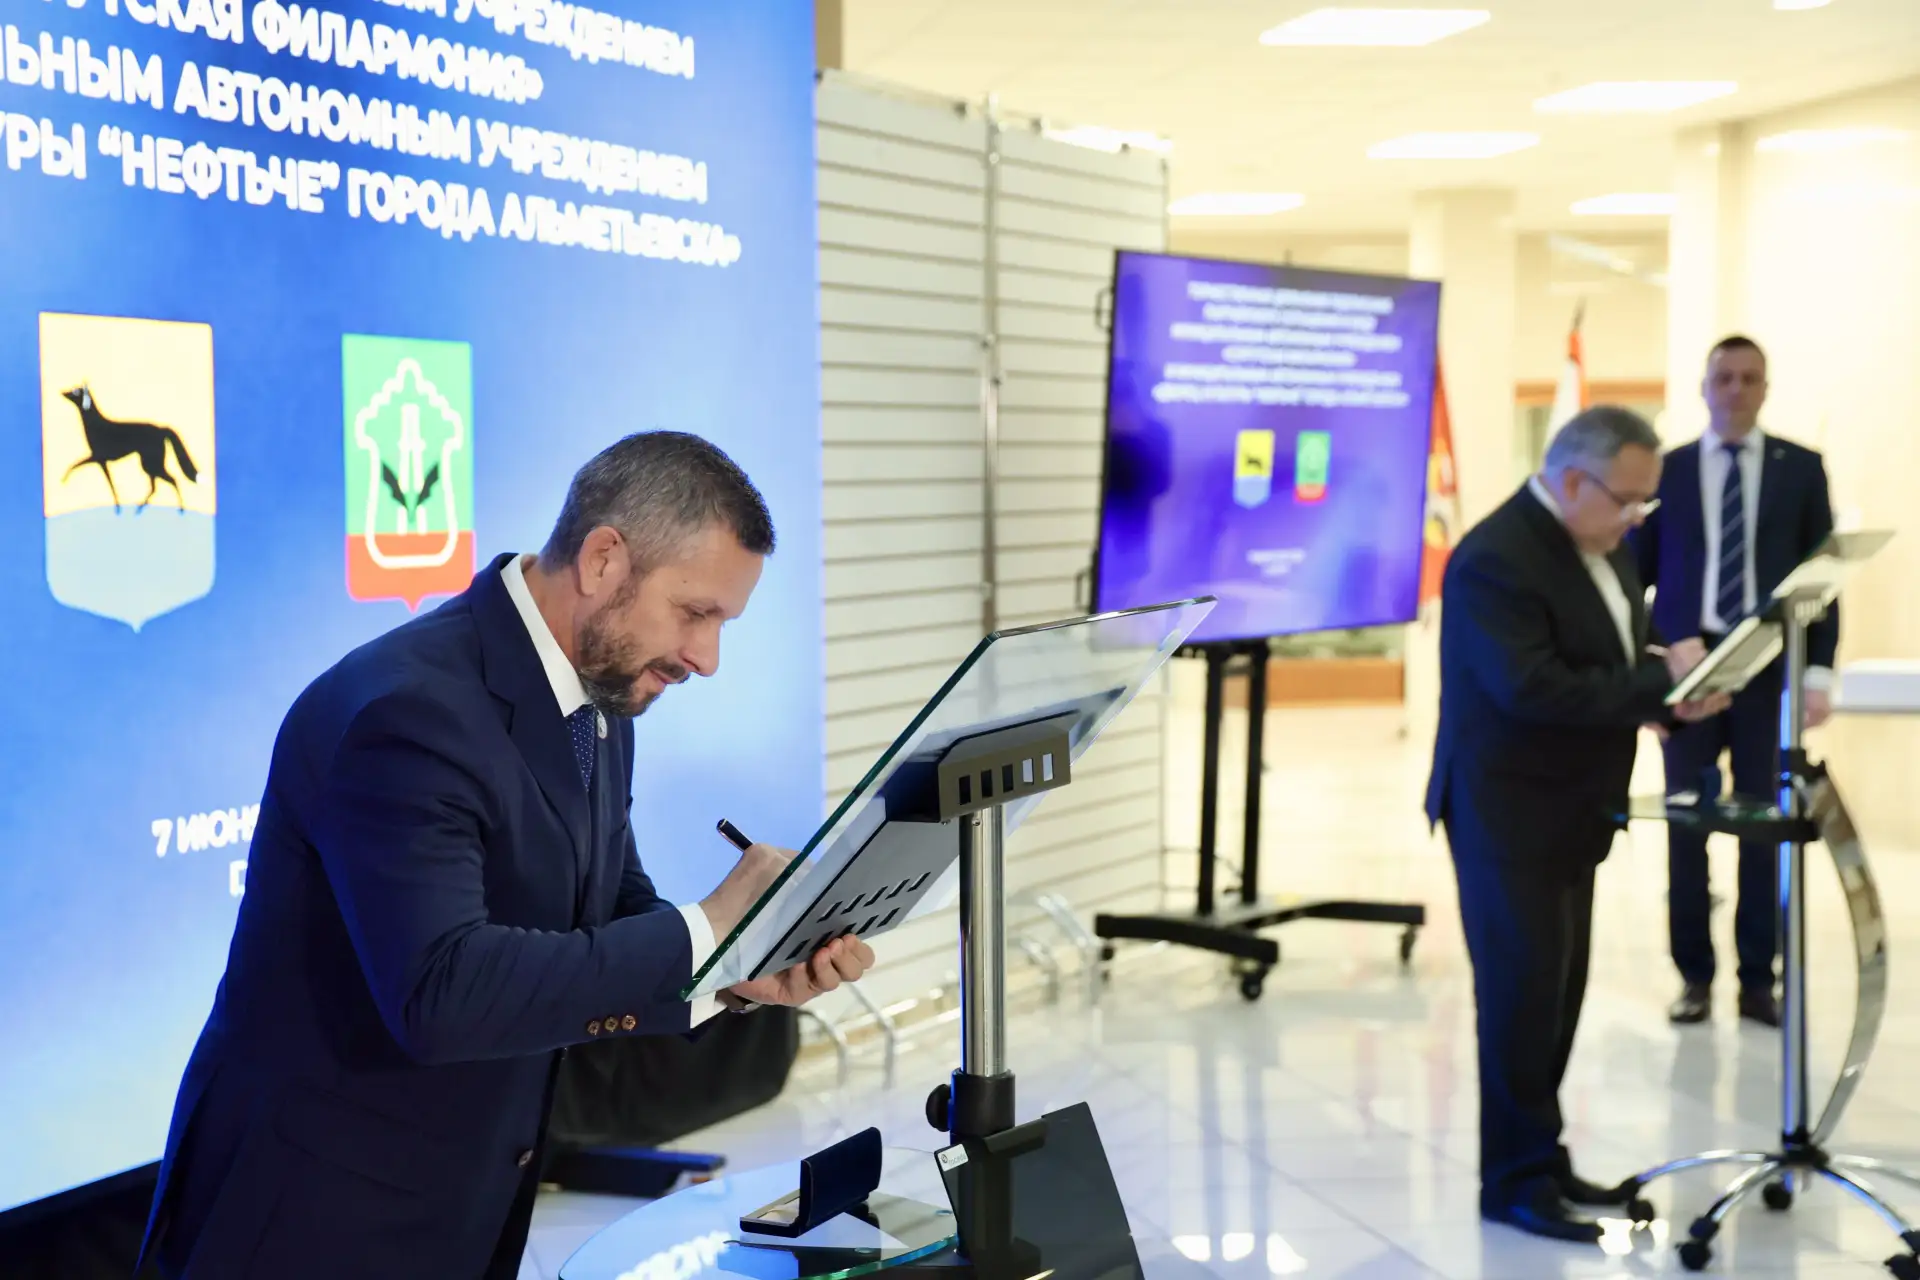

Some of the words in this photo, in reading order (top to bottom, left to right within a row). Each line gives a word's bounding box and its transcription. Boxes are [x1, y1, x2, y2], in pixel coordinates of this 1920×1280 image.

[66, 0, 244, 43] КАЯ
[0, 24, 163, 109] ЬНЫМ
[174, 61, 471, 163] АВТОНОМНЫМ
[477, 118, 708, 204] УЧРЕЖДЕНИЕМ
[348, 168, 496, 242] ГОРОДА
[151, 818, 173, 858] 7
